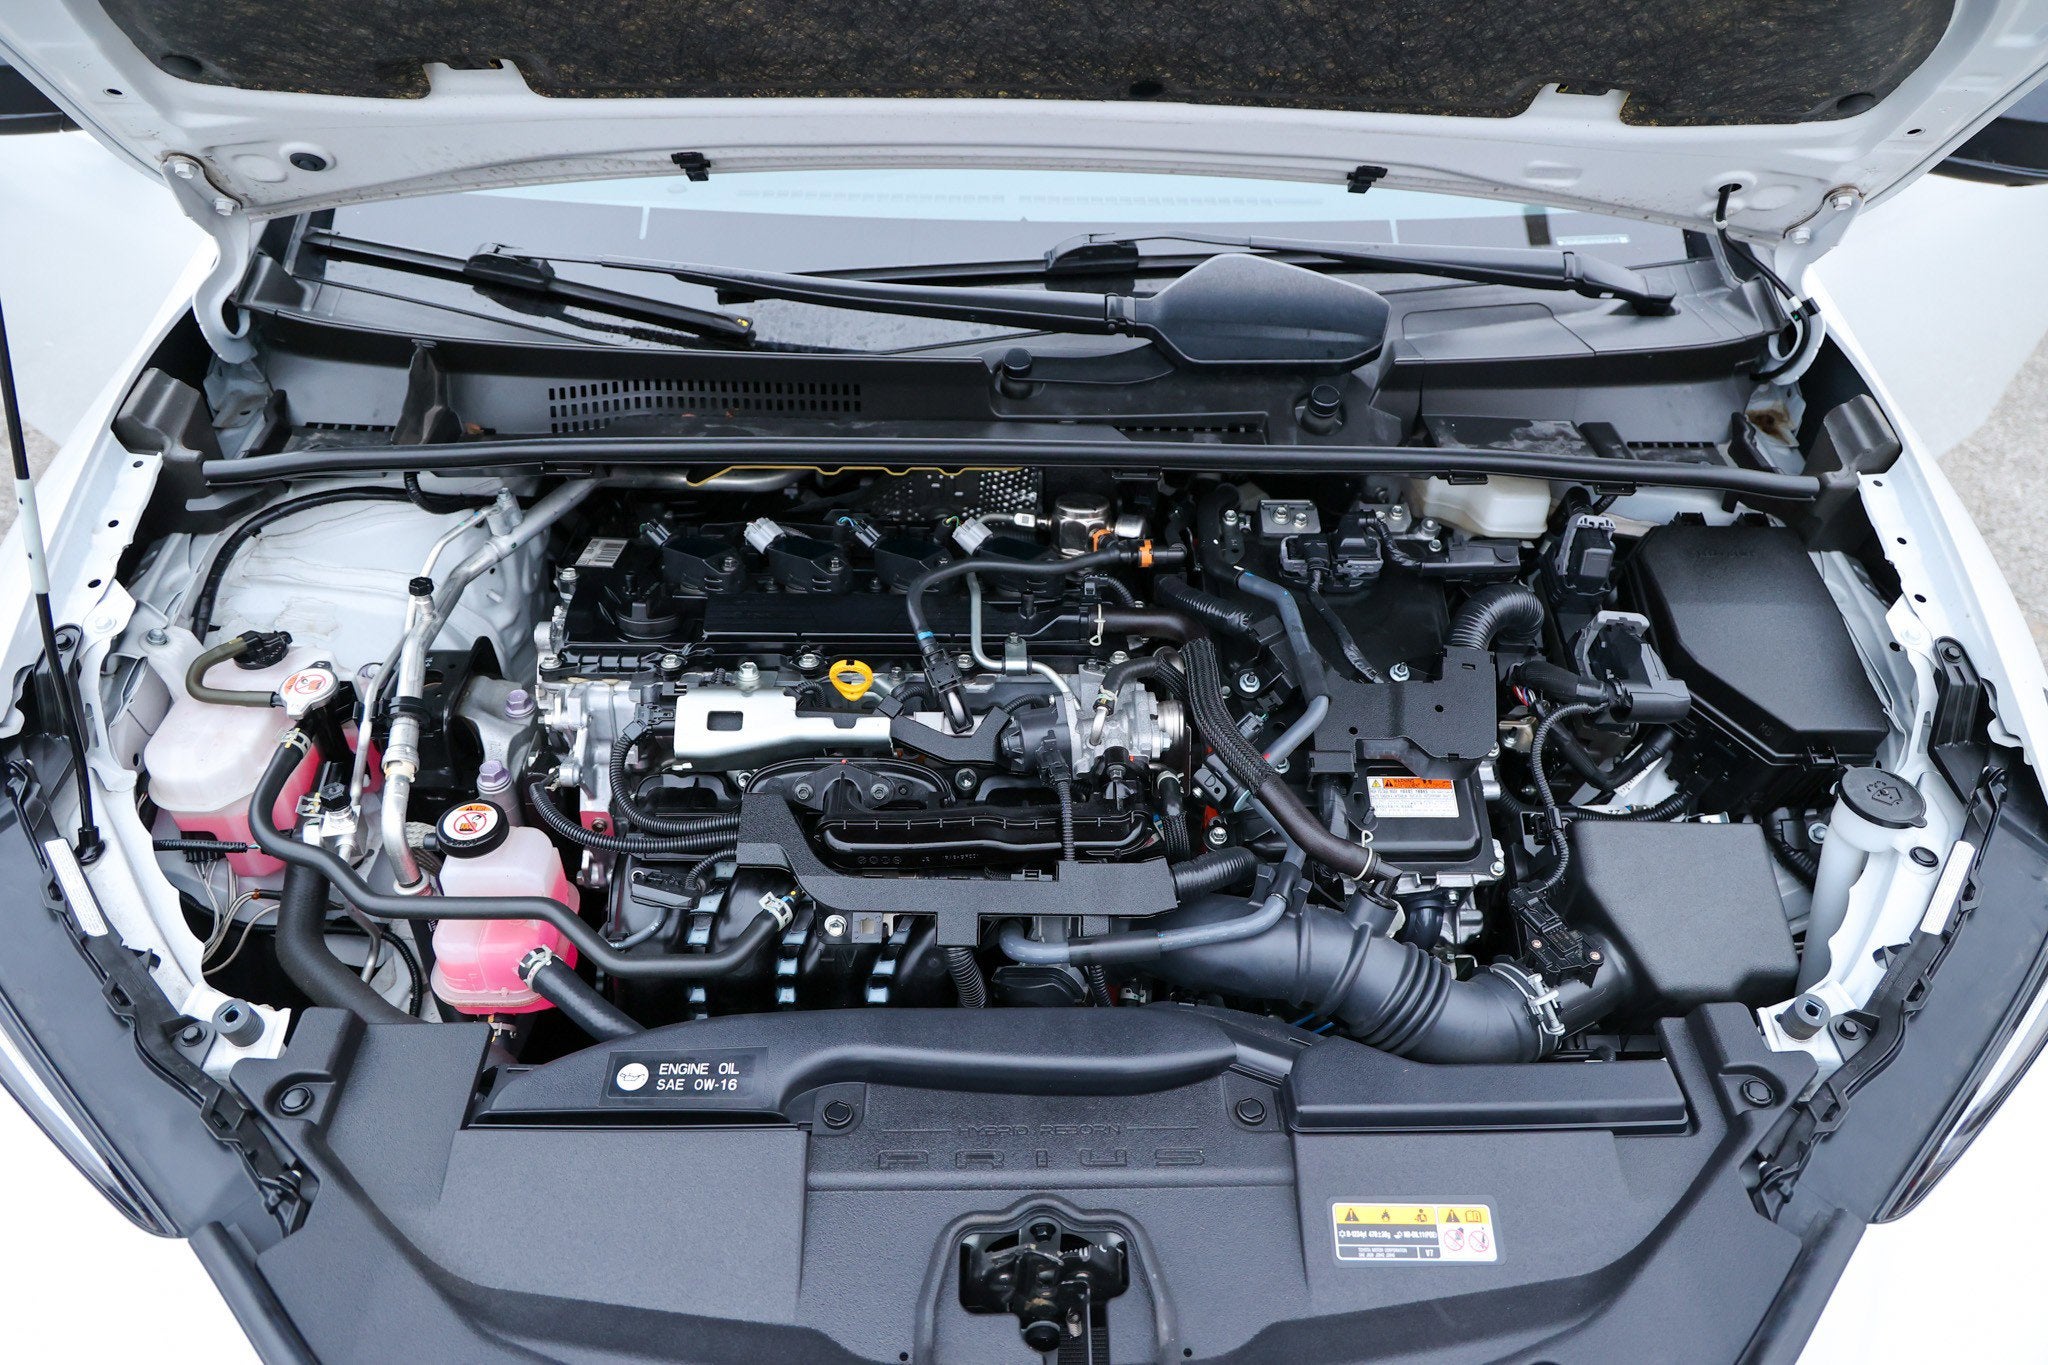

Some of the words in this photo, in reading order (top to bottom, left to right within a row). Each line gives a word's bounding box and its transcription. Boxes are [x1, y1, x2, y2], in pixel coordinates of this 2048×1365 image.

[658, 1062, 710, 1075] ENGINE
[718, 1062, 740, 1075] OIL
[656, 1078, 685, 1091] SAE
[694, 1078, 738, 1091] 0W-16
[957, 1124, 1029, 1136] HYBRID
[1039, 1123, 1122, 1136] REBORN
[877, 1148, 1205, 1170] PRIUS
